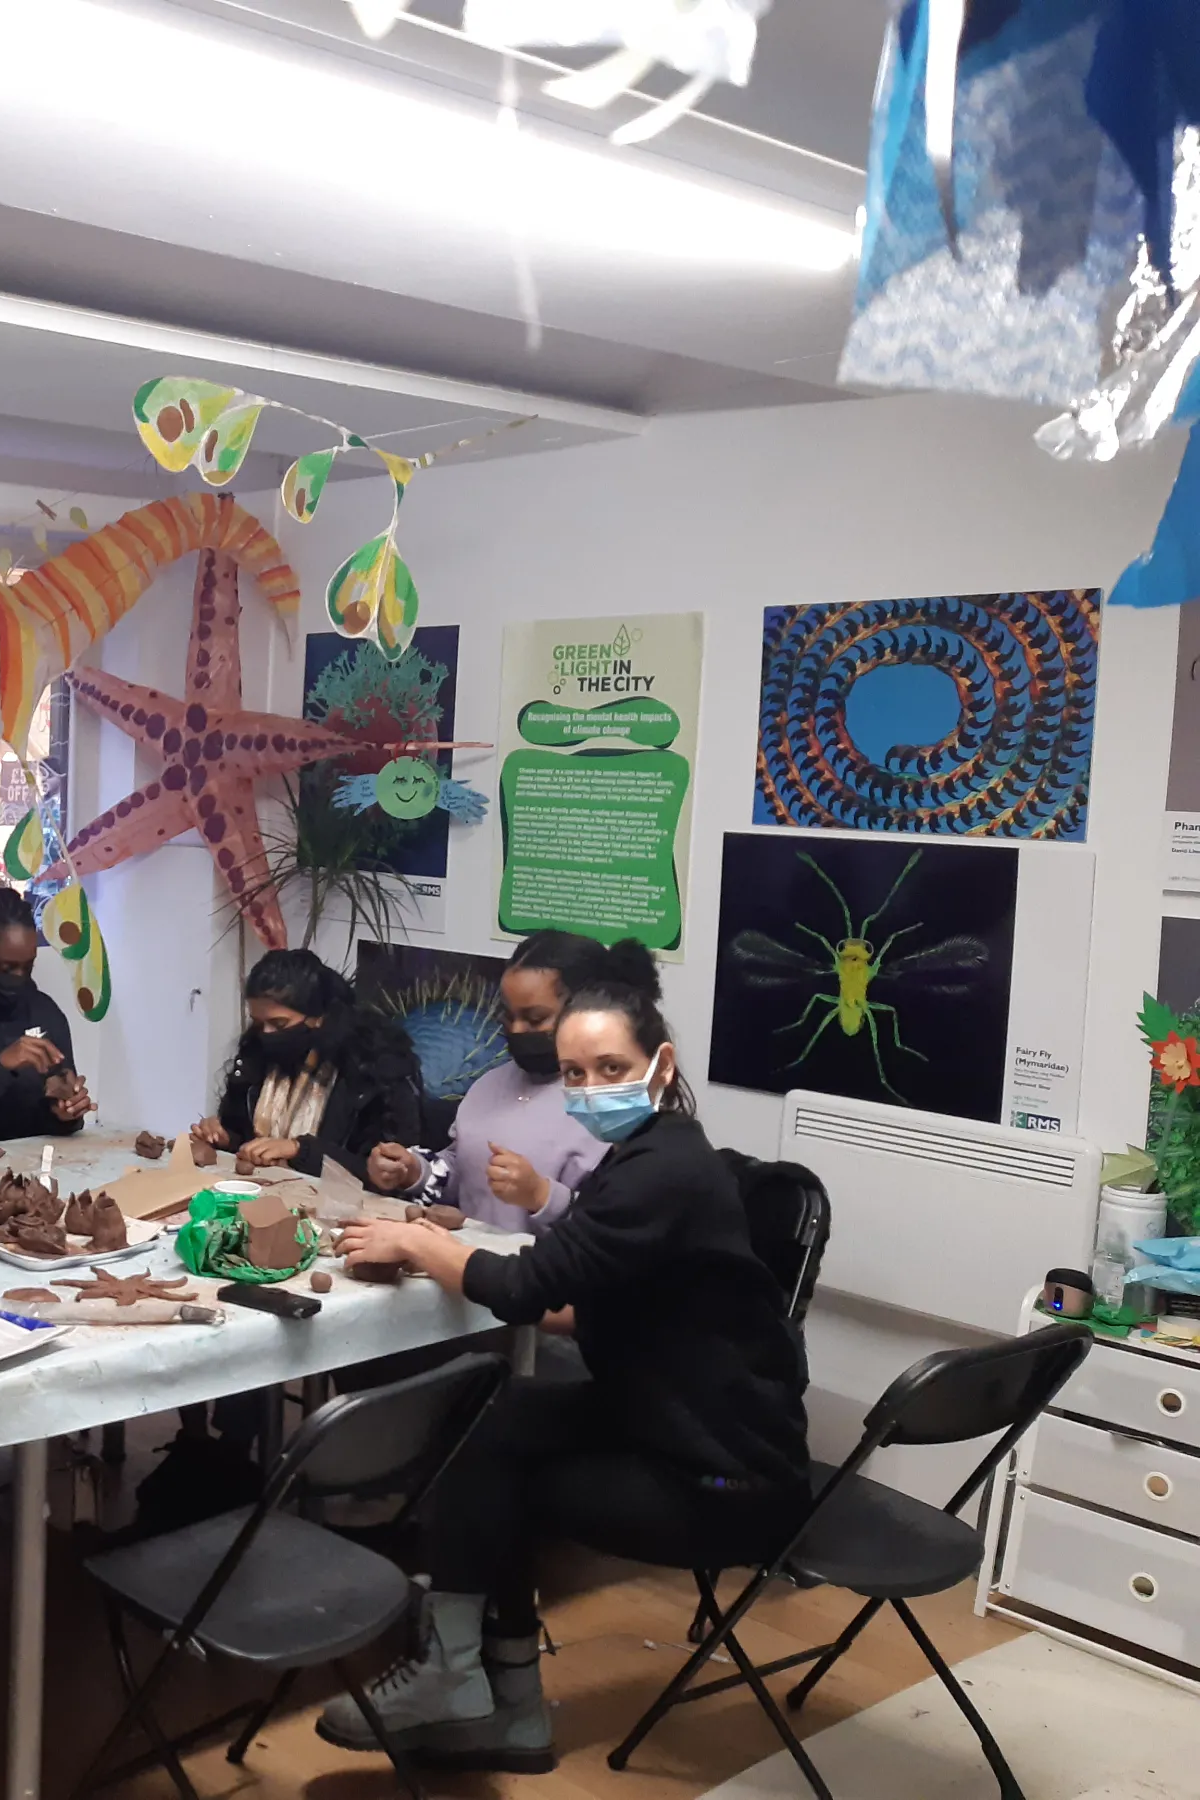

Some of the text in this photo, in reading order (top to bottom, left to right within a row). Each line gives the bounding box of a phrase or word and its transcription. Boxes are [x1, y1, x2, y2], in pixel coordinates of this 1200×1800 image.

[553, 644, 612, 660] GREEN
[560, 660, 632, 676] LIGHT IN
[577, 676, 655, 692] THE CITY
[572, 712, 585, 721] the
[586, 712, 612, 721] mental
[613, 712, 638, 721] health
[640, 712, 672, 723] impacts
[563, 725, 631, 736] of climate change
[1016, 1046, 1052, 1059] Fairy Fly
[1015, 1057, 1070, 1073] (Mymaridae)
[1027, 1116, 1060, 1132] RMS
